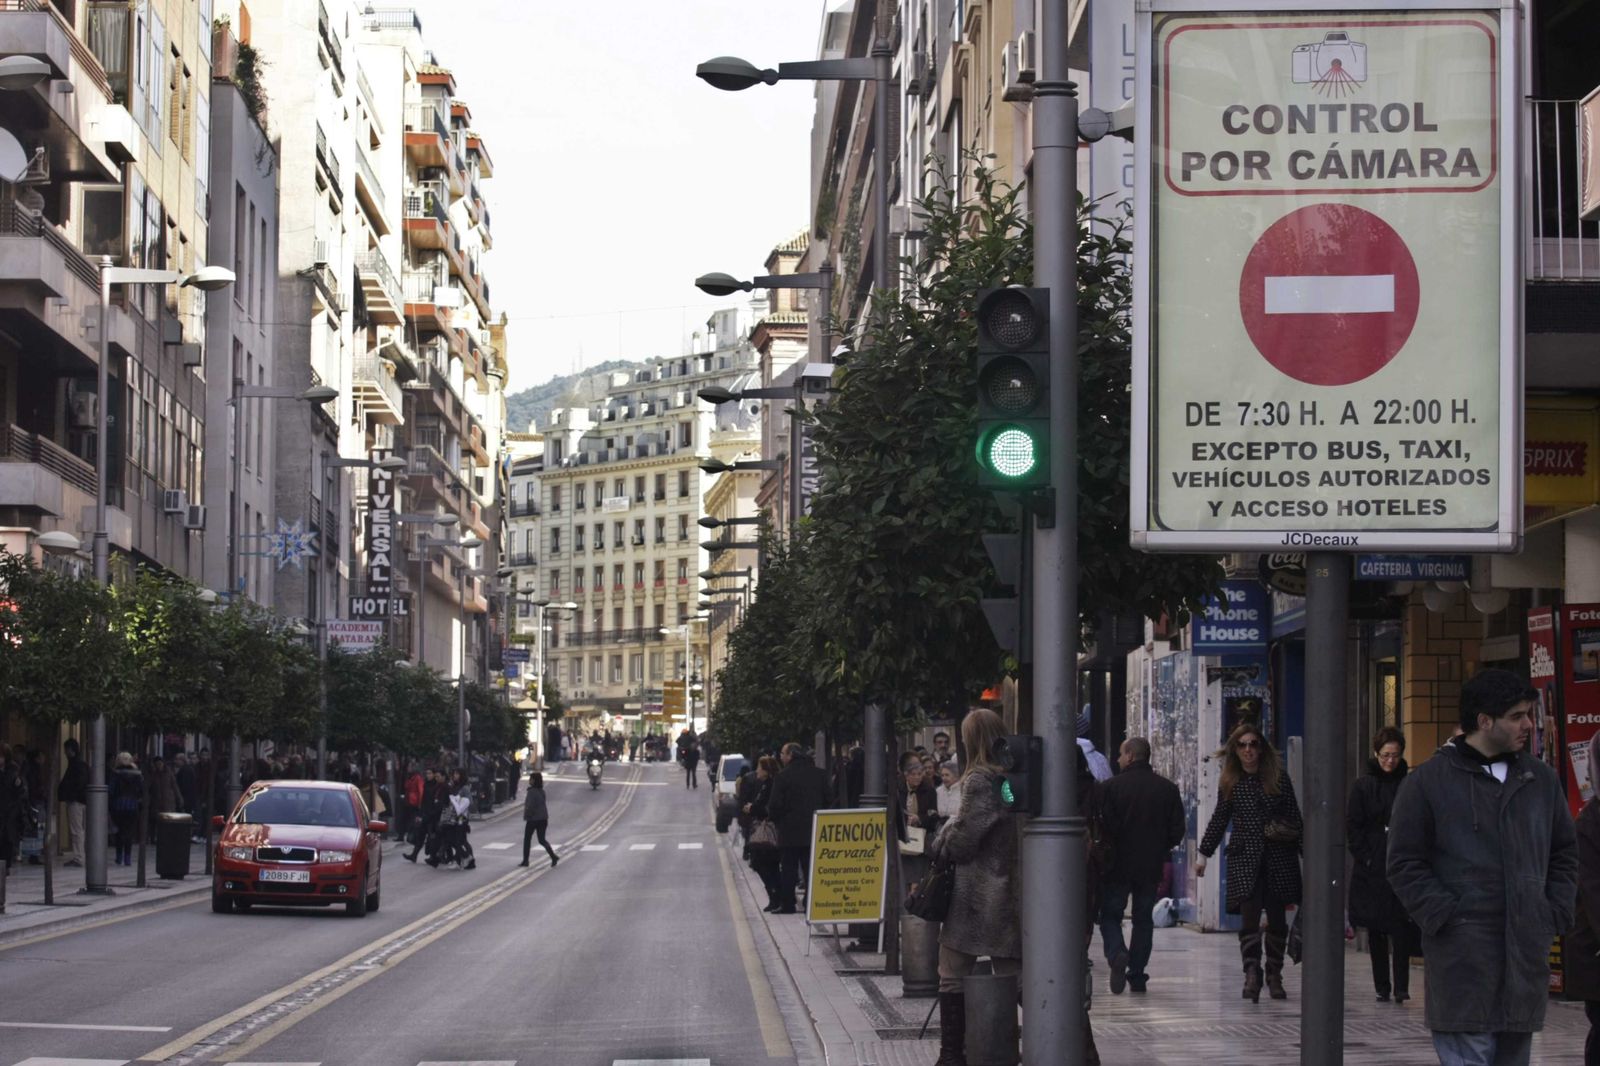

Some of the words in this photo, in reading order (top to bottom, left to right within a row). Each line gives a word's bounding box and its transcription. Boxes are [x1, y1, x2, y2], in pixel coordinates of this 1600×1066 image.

[1221, 102, 1438, 135] CONTROL
[1181, 150, 1273, 182] POR
[1287, 141, 1482, 180] CÁMARA
[1185, 402, 1222, 426] DE
[1236, 401, 1290, 426] 7:30
[1299, 401, 1325, 425] H.
[1339, 400, 1360, 425] A
[1373, 399, 1442, 425] 22:00
[1451, 398, 1477, 424] H.
[1191, 441, 1318, 461] EXCEPTO
[1327, 440, 1390, 463] BUS,
[1398, 439, 1471, 463] TAXI,
[1172, 466, 1311, 488] VEHÍCULOS
[1318, 468, 1491, 487] AUTORIZADOS
[371, 450, 392, 582] UNIVERSAL
[1207, 500, 1223, 517] Y
[1230, 499, 1329, 518] ACCESO
[1336, 498, 1447, 516] HOTELES
[1281, 532, 1359, 546] JCDecaux
[1360, 561, 1413, 576] CAFETERIA
[1417, 562, 1465, 577] VIRGINIA
[352, 598, 408, 615] HOTEL
[328, 623, 380, 633] ACADEMIA
[1200, 625, 1260, 641] House
[818, 818, 885, 843] ATENCIÓN
[265, 871, 289, 880] 2089
[290, 872, 309, 881] FJH
[817, 866, 862, 876] Compramos
[864, 865, 880, 873] Oro
